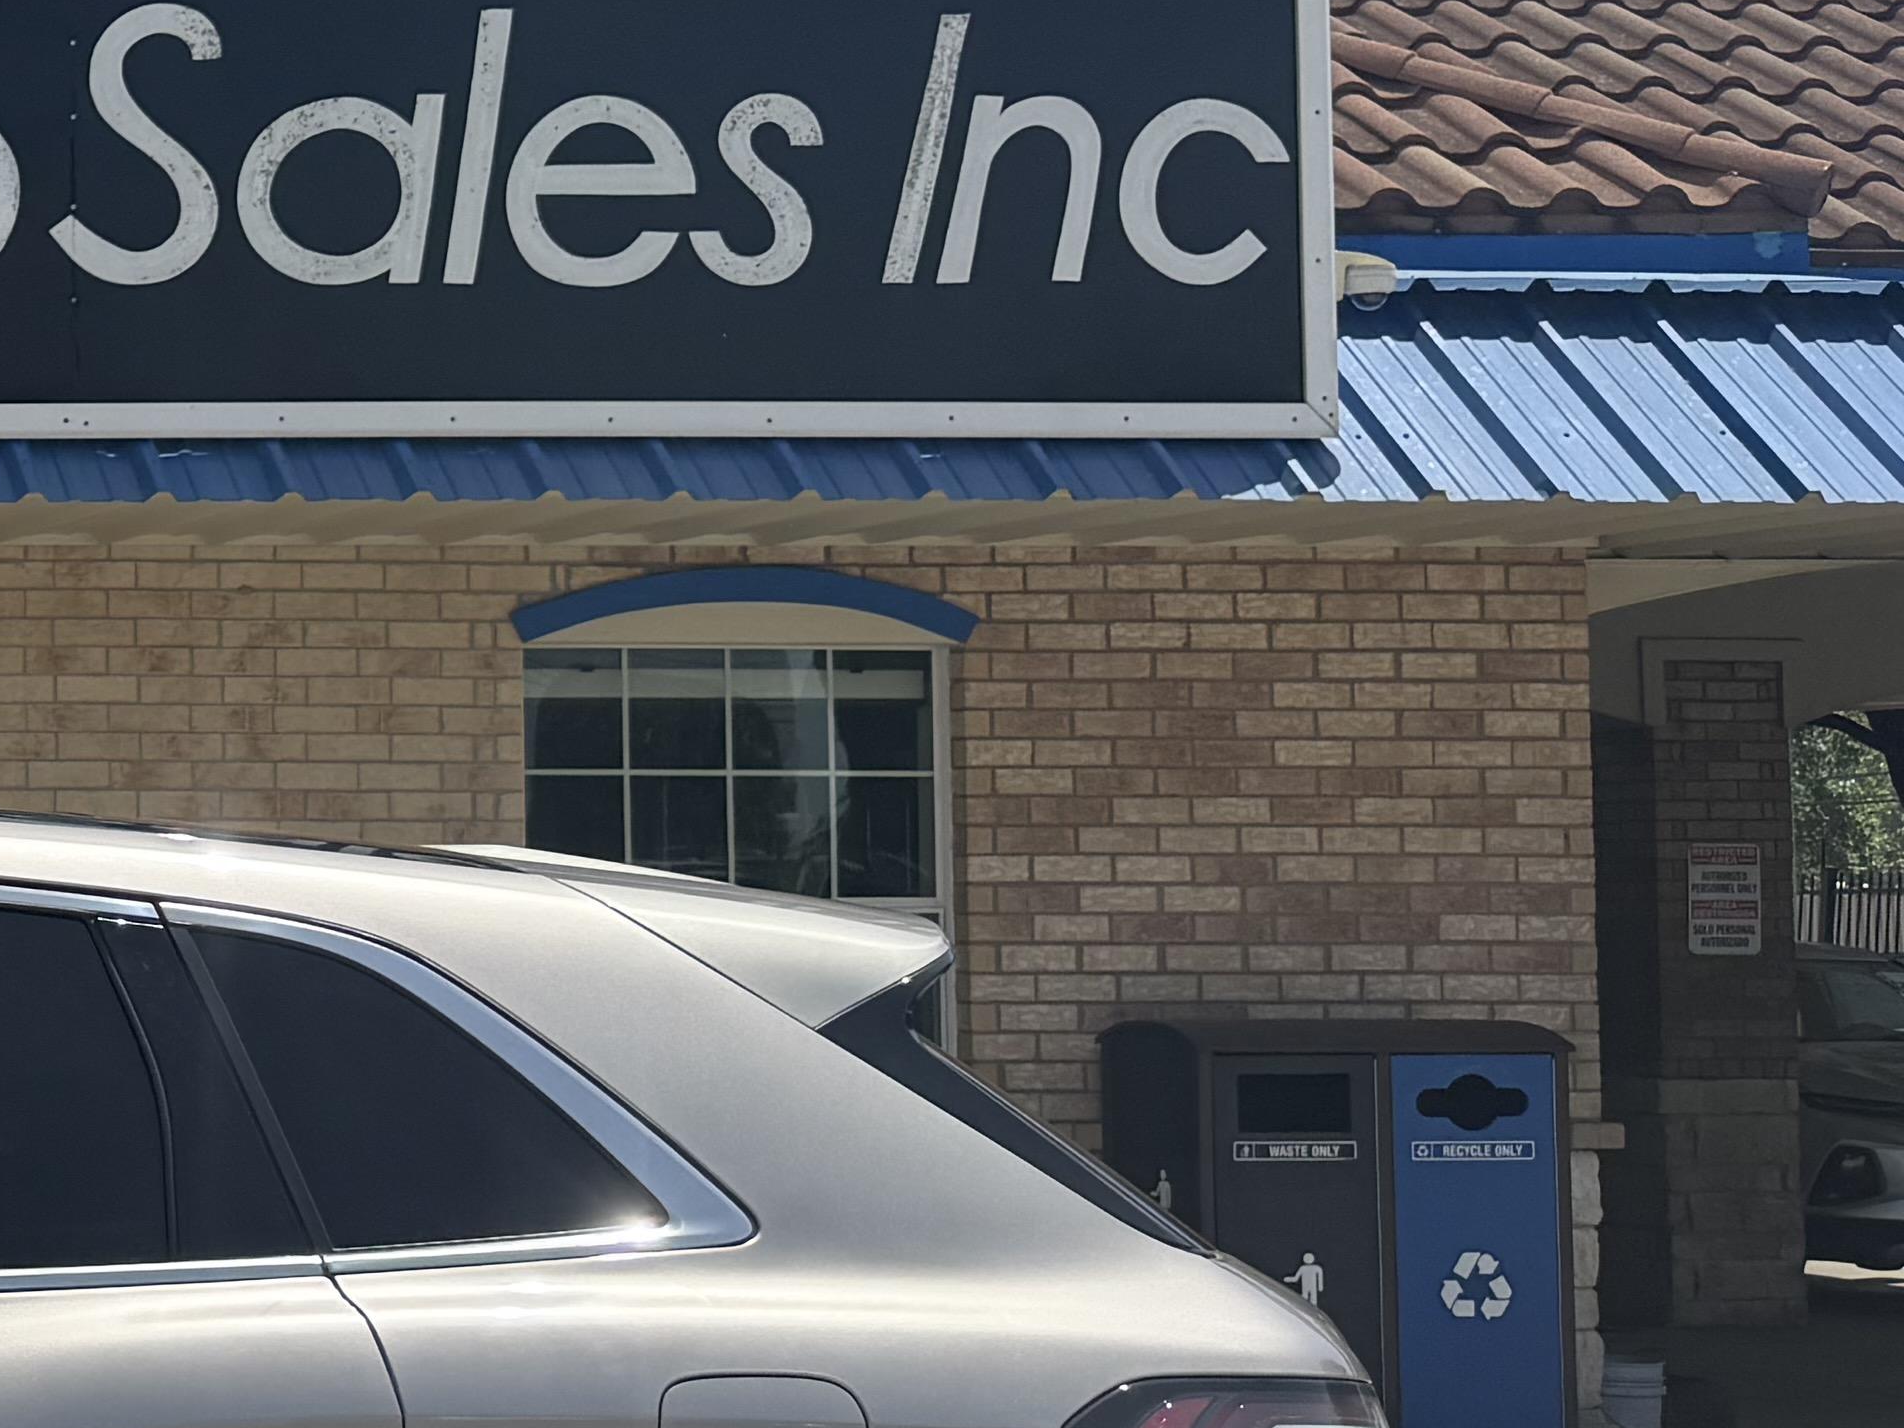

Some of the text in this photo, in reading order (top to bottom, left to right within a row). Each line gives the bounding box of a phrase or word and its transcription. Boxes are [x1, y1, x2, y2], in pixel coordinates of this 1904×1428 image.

[48, 2, 824, 288] Sales
[881, 13, 1291, 286] Inc
[1269, 1145, 1340, 1157] WASTE ONLY
[1442, 1144, 1523, 1157] RECYCLE ONLY
